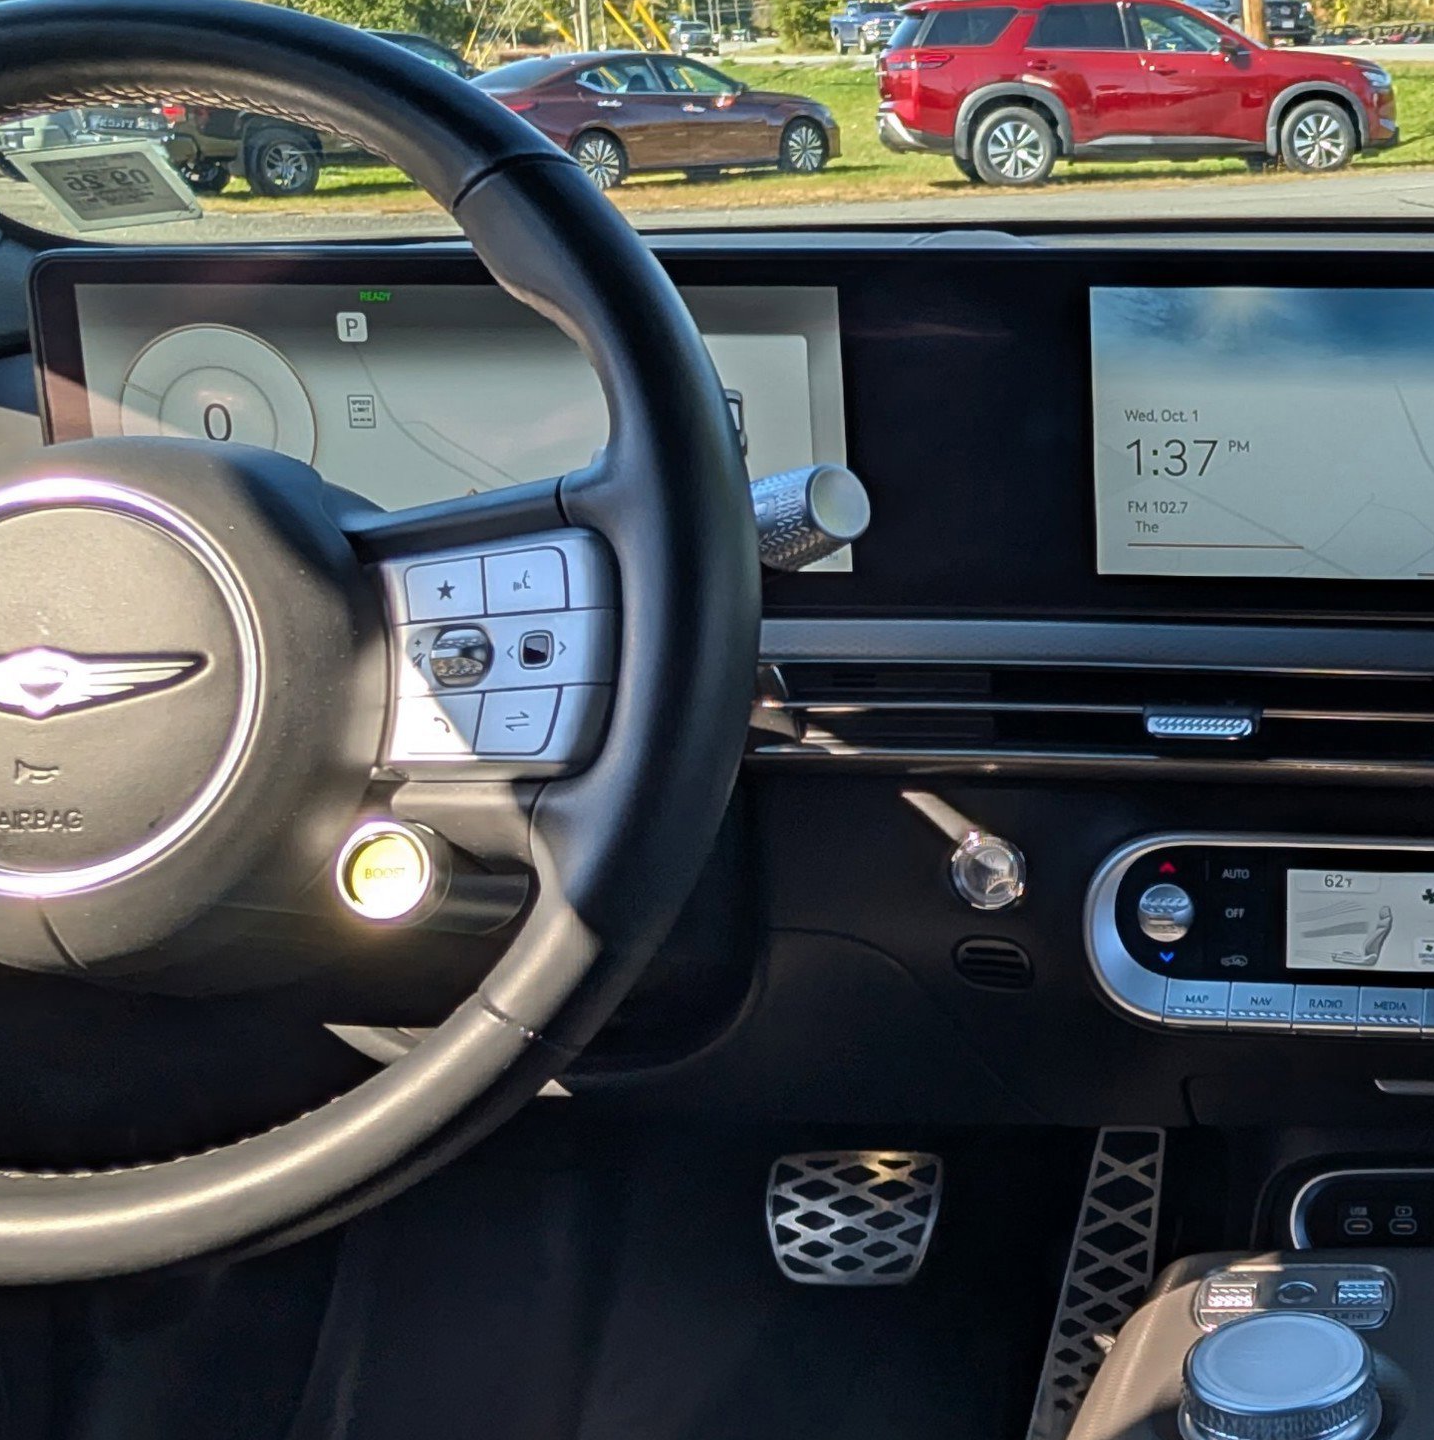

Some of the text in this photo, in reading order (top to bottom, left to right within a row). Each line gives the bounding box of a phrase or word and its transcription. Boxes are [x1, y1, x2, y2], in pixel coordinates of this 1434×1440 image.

[359, 291, 391, 301] READY
[345, 317, 359, 337] P
[203, 403, 232, 441] 0
[1124, 409, 1199, 423] Wed, Oct. 1
[1126, 438, 1250, 477] 1:37 PM
[1127, 500, 1188, 515] FM 102.7
[1135, 520, 1160, 533] The
[365, 867, 405, 880] BOOST
[1221, 868, 1250, 880] AUTO
[1225, 907, 1245, 919] OFF
[1184, 993, 1210, 1005] MAP
[1250, 996, 1273, 1006] NAV
[1308, 997, 1344, 1009] RADIO
[1373, 1000, 1408, 1011] MEDIA
